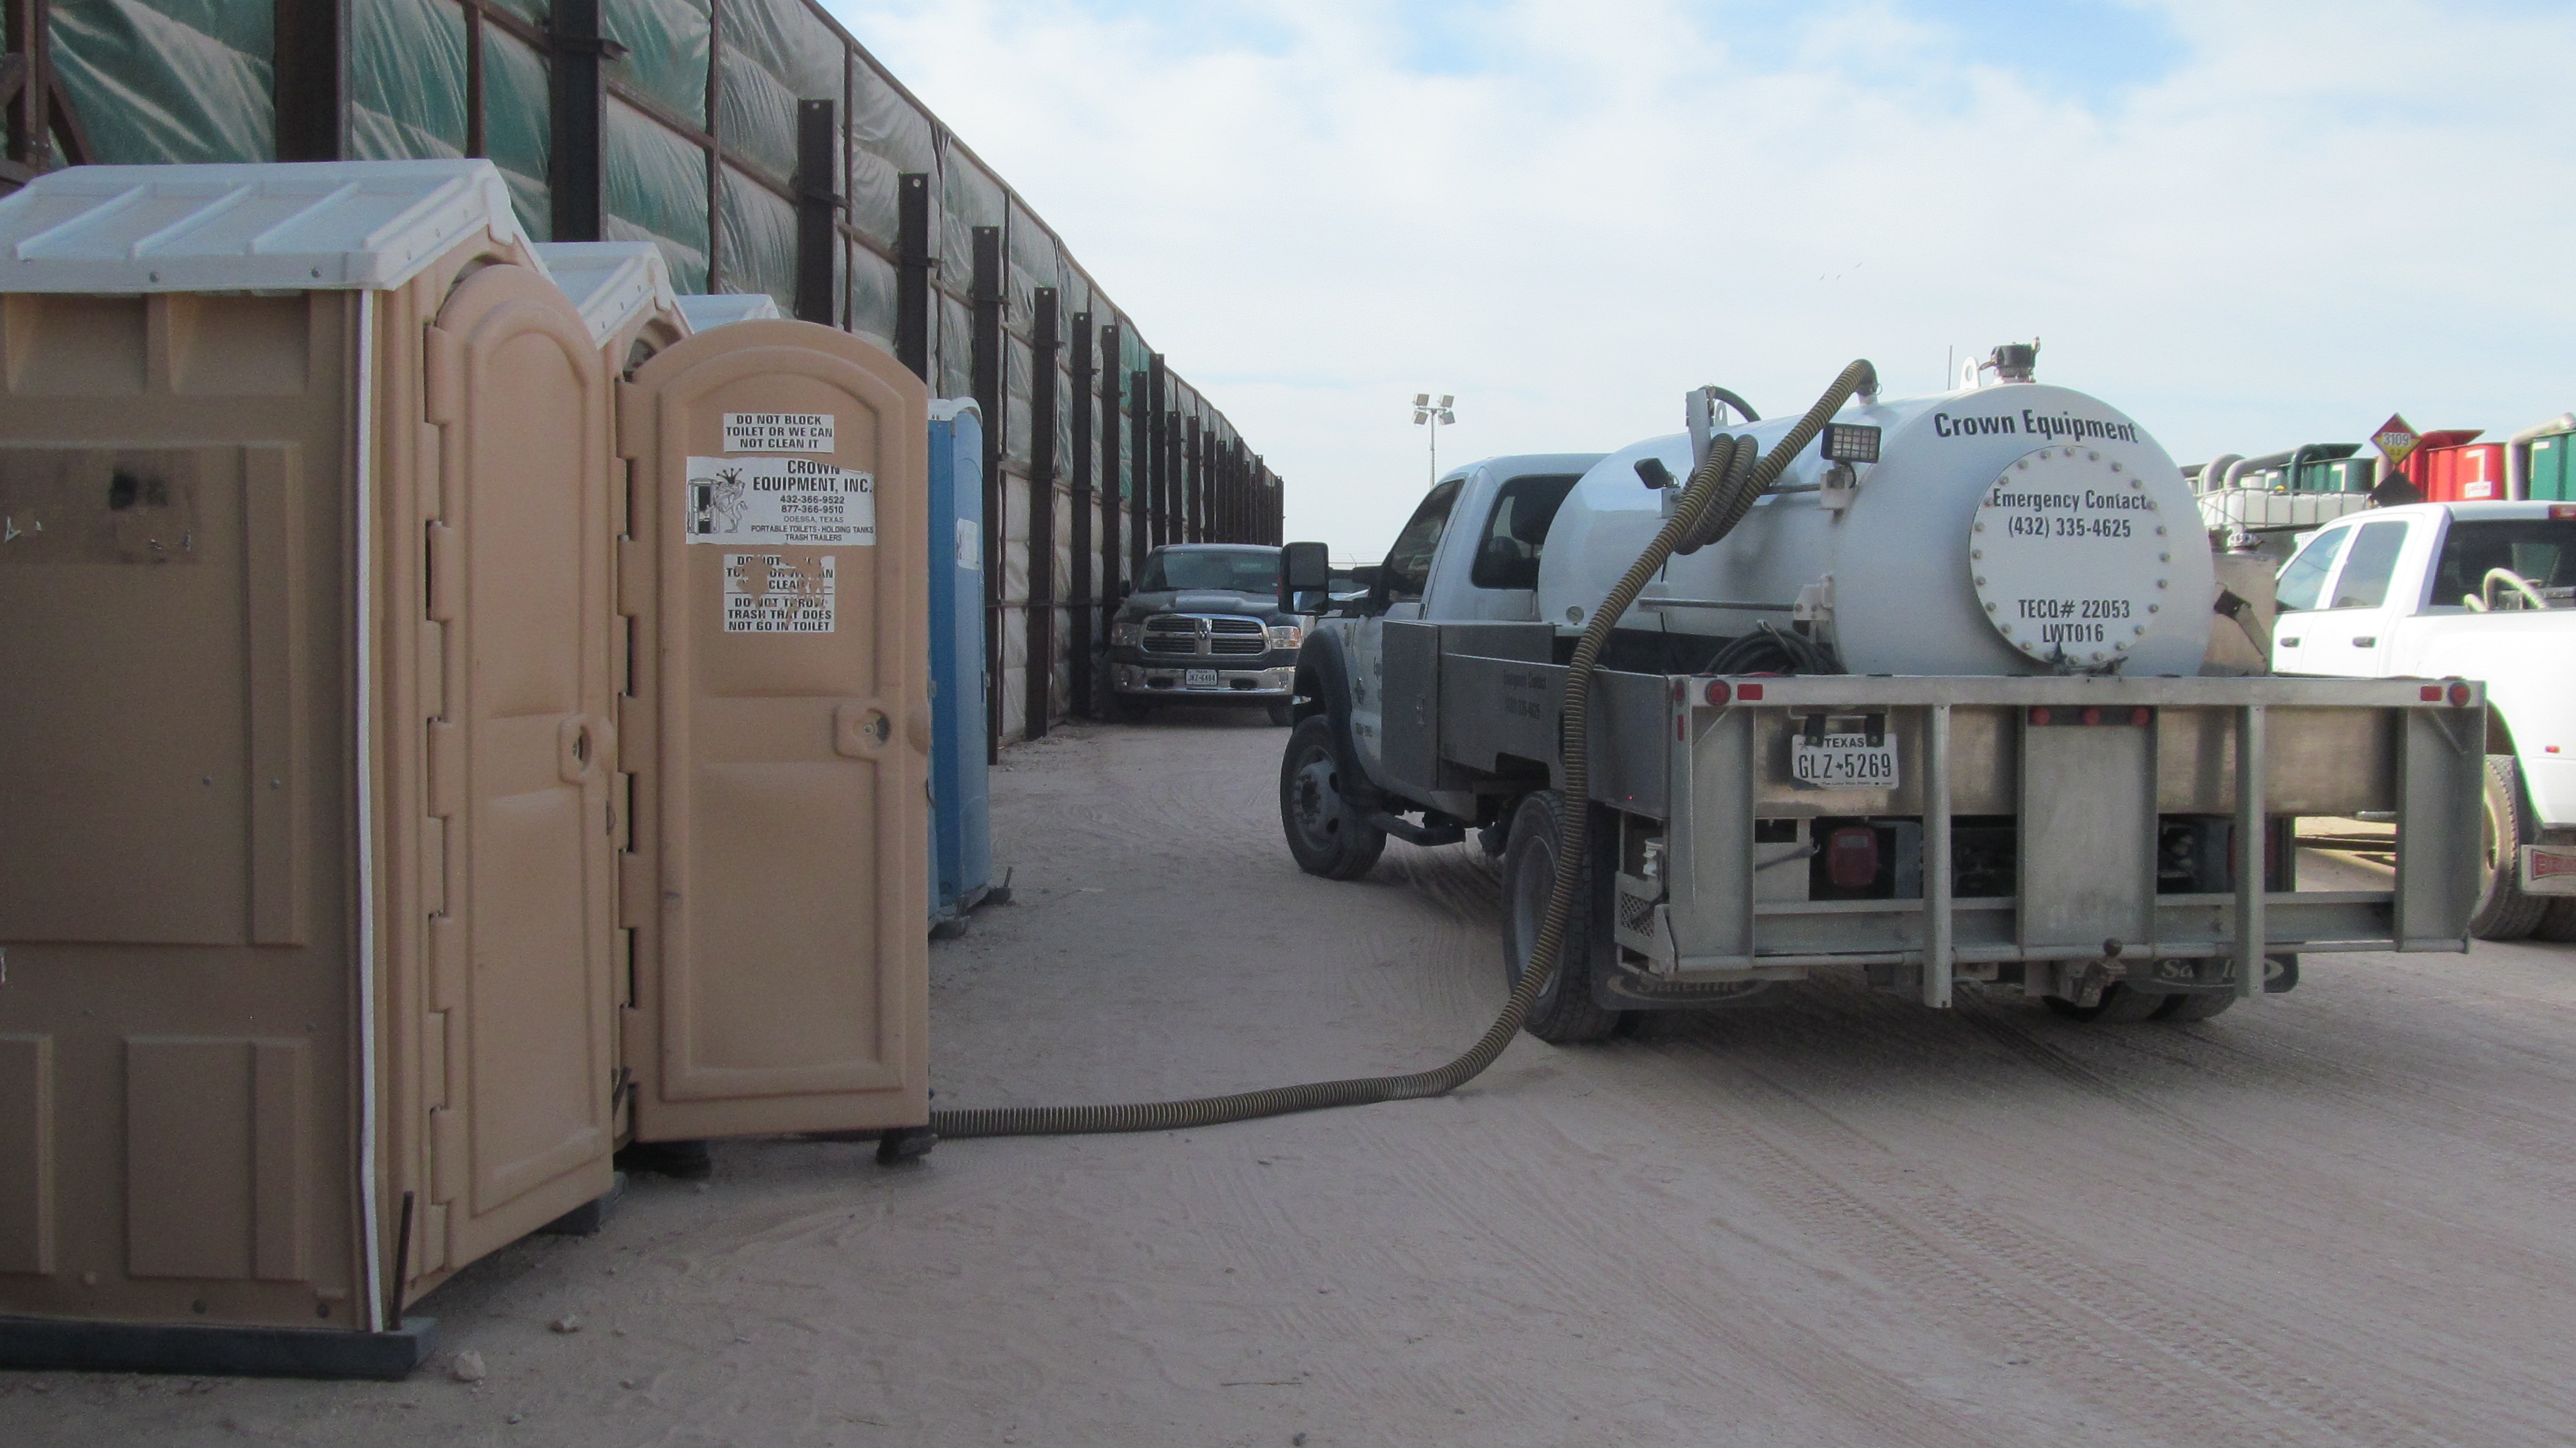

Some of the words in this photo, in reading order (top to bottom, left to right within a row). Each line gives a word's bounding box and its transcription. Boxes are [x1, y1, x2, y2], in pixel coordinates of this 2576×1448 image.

[736, 415, 754, 425] DO
[758, 415, 782, 425] NOT
[785, 415, 822, 425] BLOCK
[1935, 412, 2016, 437] Crown
[2022, 409, 2138, 443] Equipment
[726, 426, 764, 436] TOILET
[769, 427, 785, 436] OR
[788, 427, 807, 437] WE
[811, 427, 833, 438] CAN
[740, 438, 764, 448] NOT
[768, 438, 804, 449] CLEAN
[808, 439, 819, 449] IT
[2383, 432, 2409, 446] 3109
[787, 460, 841, 475] CROWN
[753, 476, 839, 494] EQUIPMENT,
[844, 478, 873, 493] INC.
[780, 496, 846, 504] 432-366-9522
[1993, 488, 2081, 512] Emergency
[2085, 489, 2148, 510] Contact
[781, 504, 844, 514] 877-366-9510
[852, 526, 874, 534] TANKS
[2008, 516, 2050, 538] (432)
[2056, 518, 2132, 537] 335-4625
[763, 556, 781, 566] OT
[734, 597, 751, 607] DO
[727, 609, 766, 619] TRASH
[802, 610, 832, 619] DOES
[2018, 599, 2076, 619] TECQ#
[2081, 599, 2131, 619] 22053
[729, 621, 753, 630] NOT
[756, 621, 772, 630] GO
[776, 621, 789, 631] IN
[793, 621, 830, 631] TOILET
[2042, 624, 2104, 643] LWT016
[1824, 737, 1865, 748] TEXAS
[1798, 754, 1833, 778] GLZ
[1844, 753, 1891, 778] 5269
